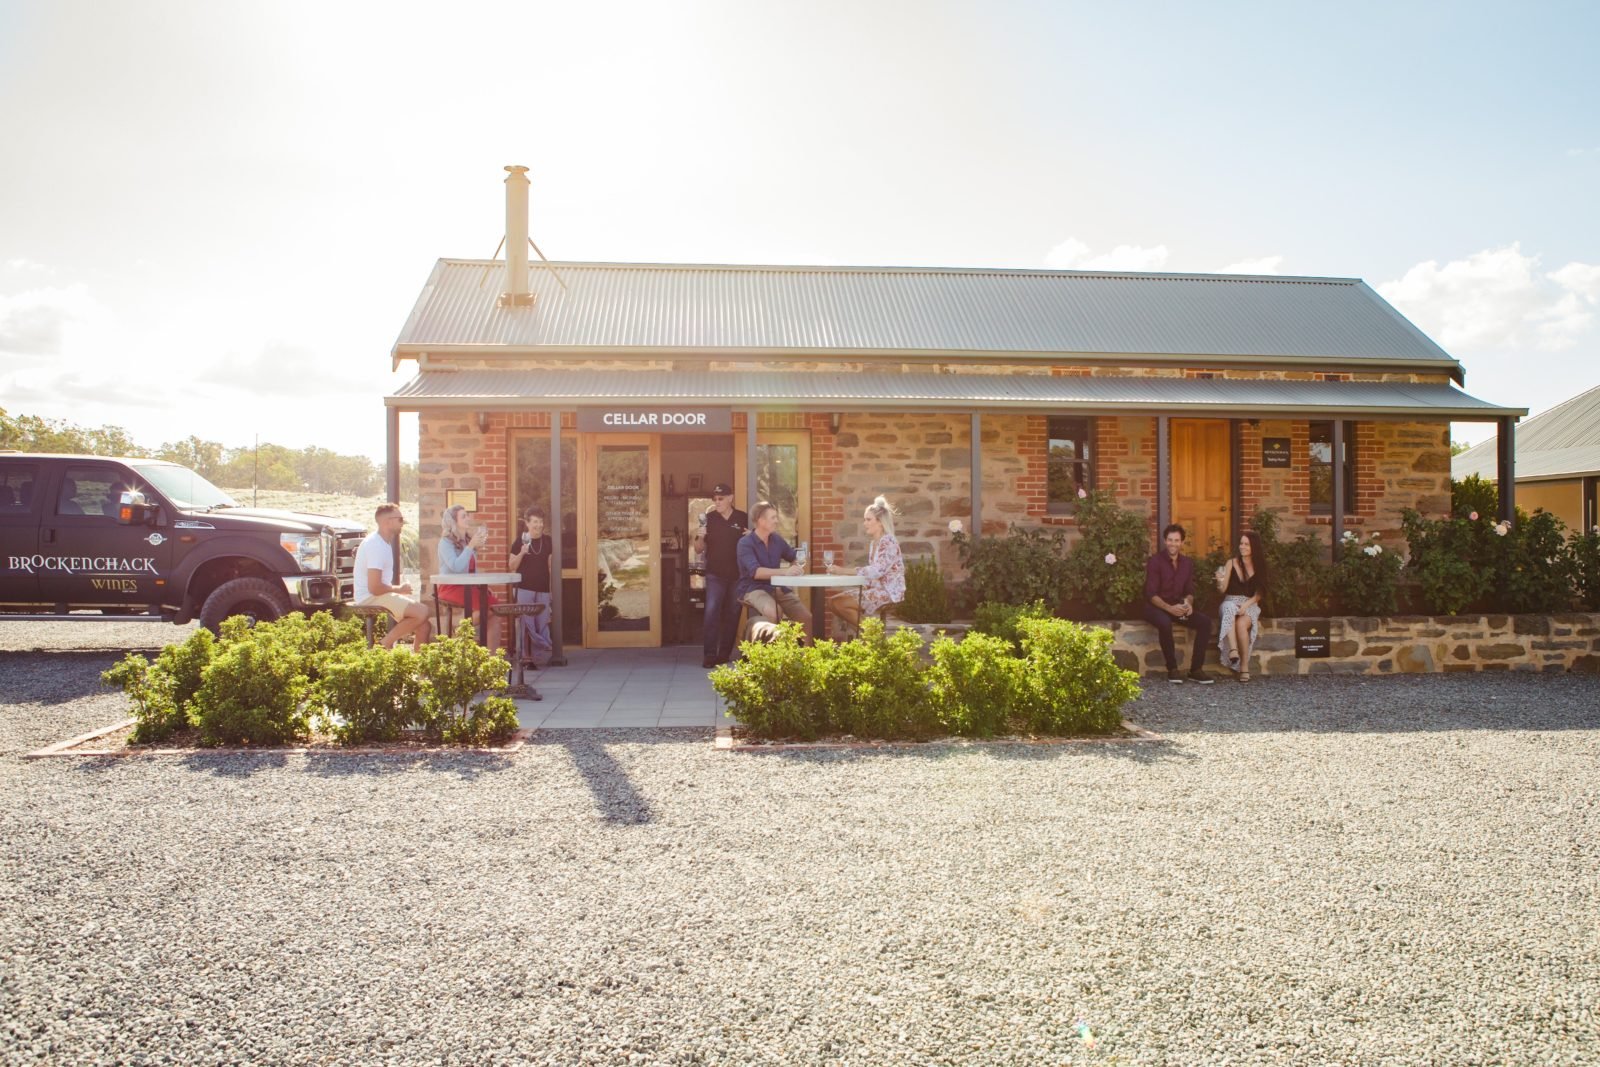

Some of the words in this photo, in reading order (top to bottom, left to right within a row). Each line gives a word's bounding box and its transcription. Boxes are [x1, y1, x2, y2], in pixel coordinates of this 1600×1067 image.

[603, 413, 658, 425] CELLAR
[662, 413, 706, 425] DOOR
[8, 554, 160, 576] BROCKENCHACK
[91, 579, 138, 590] WINES
